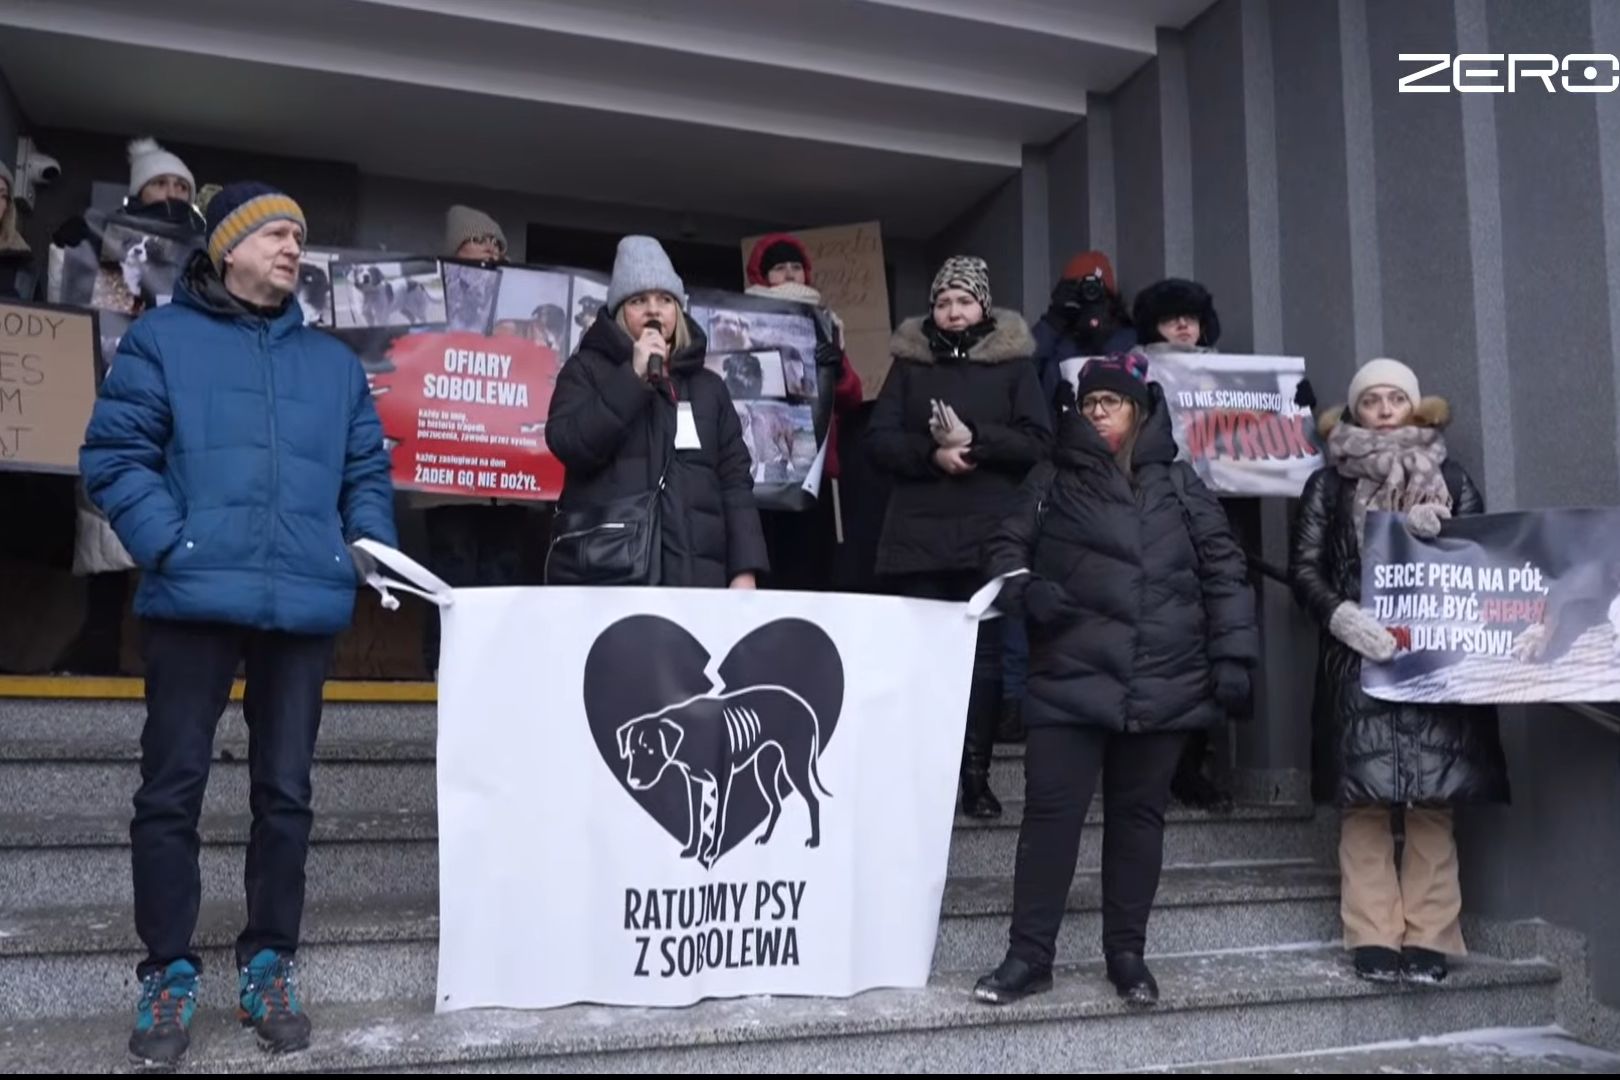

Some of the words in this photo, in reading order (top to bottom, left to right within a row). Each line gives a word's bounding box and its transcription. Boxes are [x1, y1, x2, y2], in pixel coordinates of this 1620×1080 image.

[0, 312, 65, 340] ODY
[444, 348, 512, 379] OFIARY
[423, 373, 529, 407] SOBOLEWA
[1178, 391, 1193, 408] TO
[1195, 391, 1214, 408] NIE
[1215, 390, 1282, 411] SCHRONISKO
[1183, 410, 1320, 461] WYROK
[415, 463, 454, 484] ŻADEN
[458, 470, 474, 486] GO
[478, 471, 497, 488] NIE
[500, 470, 541, 491] DOŻYŁ.
[480, 458, 489, 467] na
[490, 458, 506, 468] dom
[1374, 562, 1425, 589] SERCE
[1428, 564, 1474, 592] PĘKA
[1478, 568, 1503, 592] NA
[1508, 561, 1550, 596] PÓŁ,
[1374, 596, 1394, 619] TU
[1397, 594, 1439, 619] MIAŁ
[1443, 593, 1479, 622] BYĆ
[1414, 625, 1446, 651] DLA
[1451, 623, 1513, 655] PSÓW!
[624, 882, 749, 930] RATUJMY
[754, 880, 807, 921] PSY
[634, 936, 651, 977] Z
[660, 927, 800, 978] SOBOLEWA
